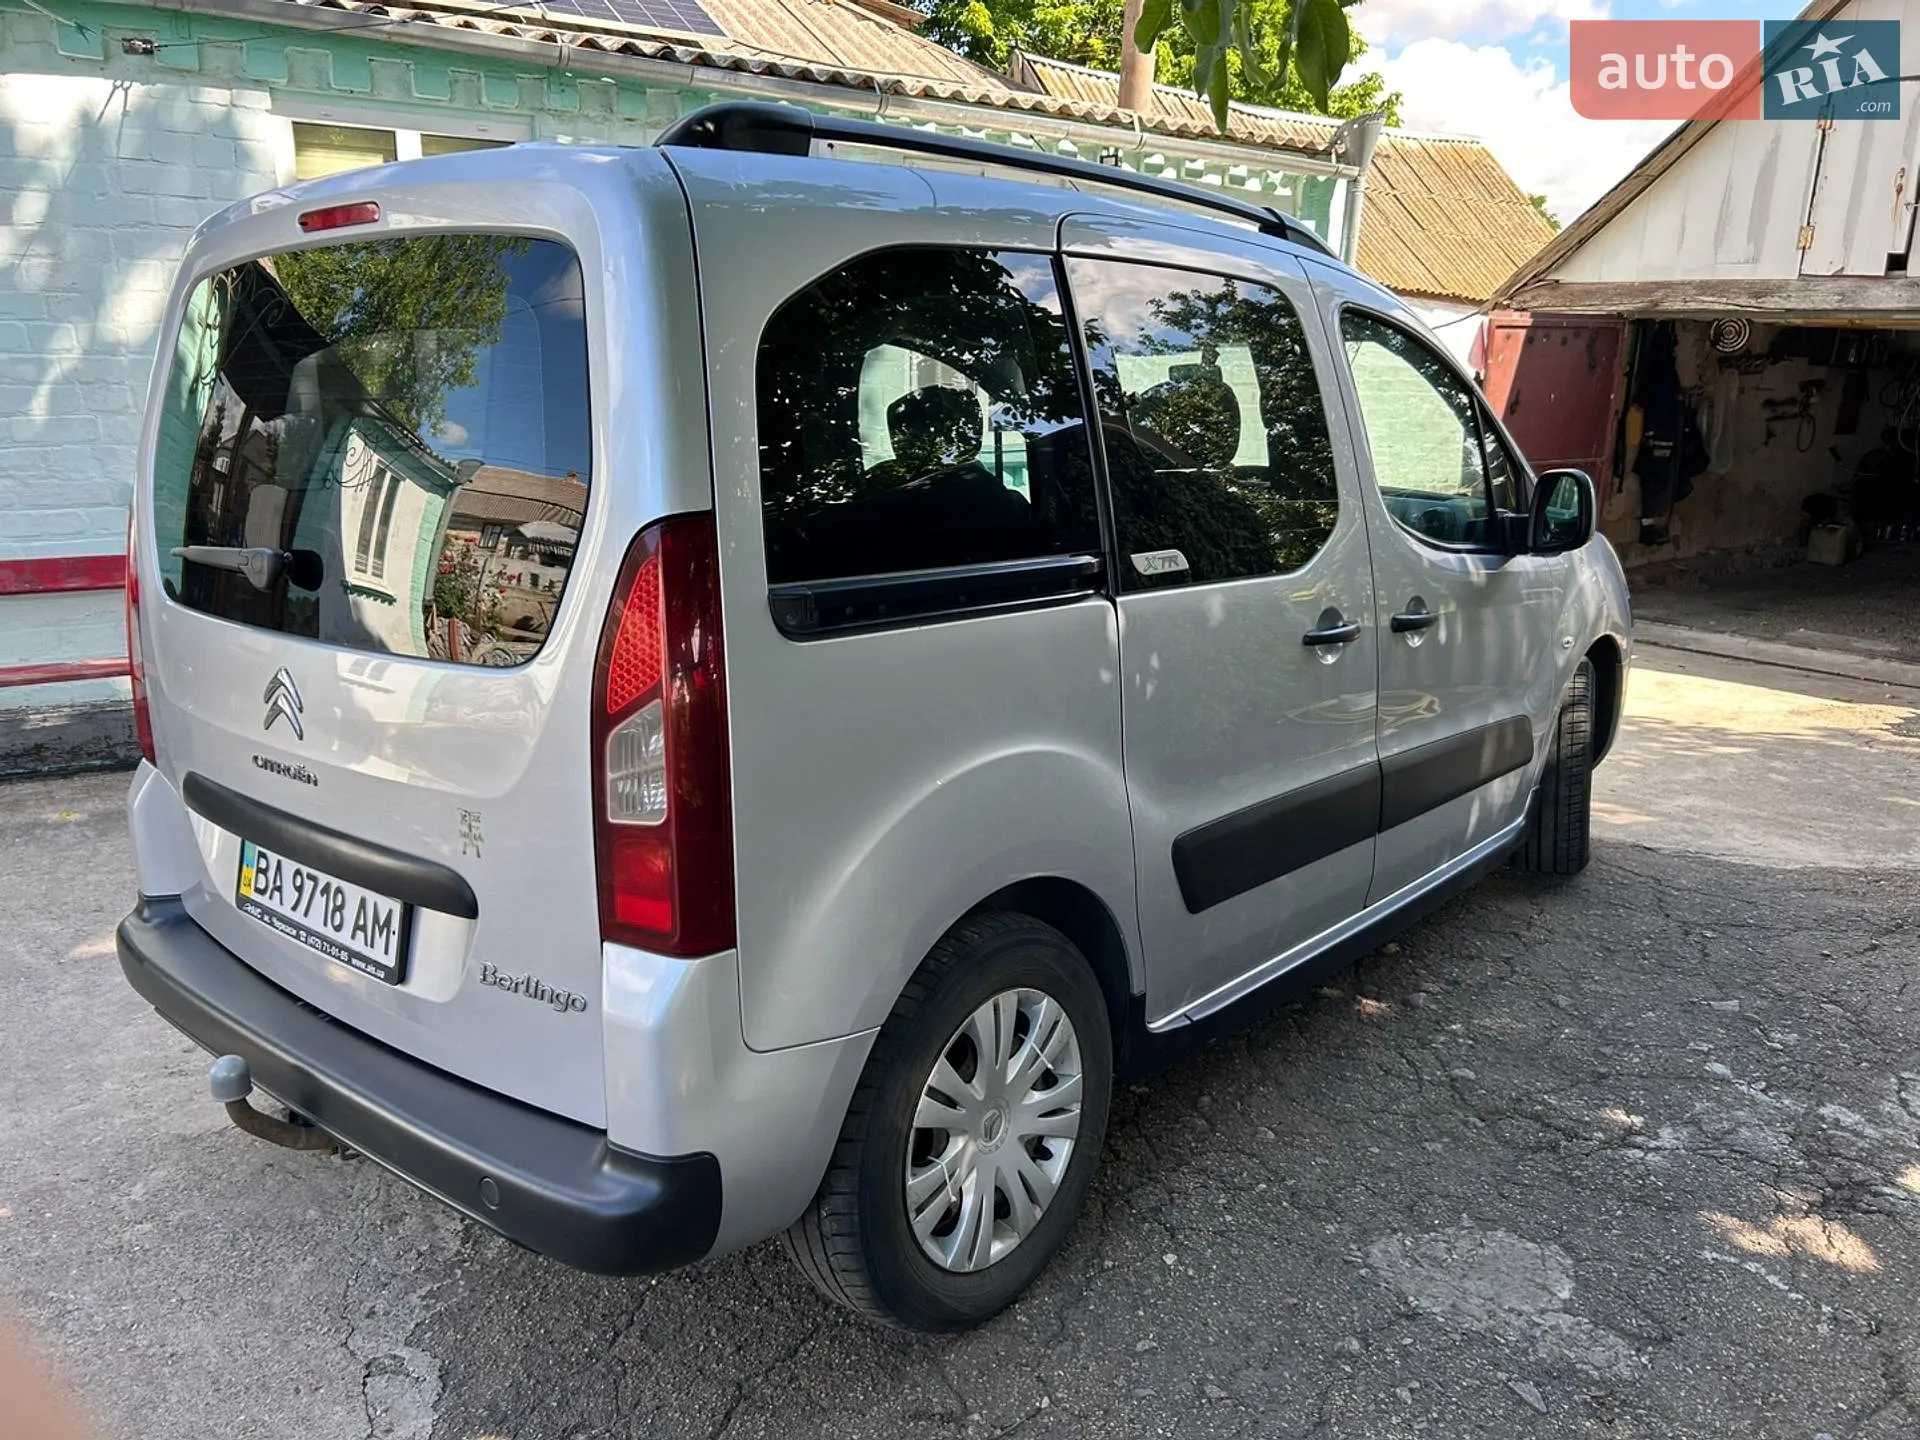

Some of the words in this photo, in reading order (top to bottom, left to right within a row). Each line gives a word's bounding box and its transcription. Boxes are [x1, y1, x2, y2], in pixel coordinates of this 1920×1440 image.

[1143, 554, 1179, 572] XTR
[254, 849, 284, 906] BA
[290, 867, 346, 933] 9718
[350, 895, 393, 956] AM
[480, 960, 587, 1013] Berlingo
